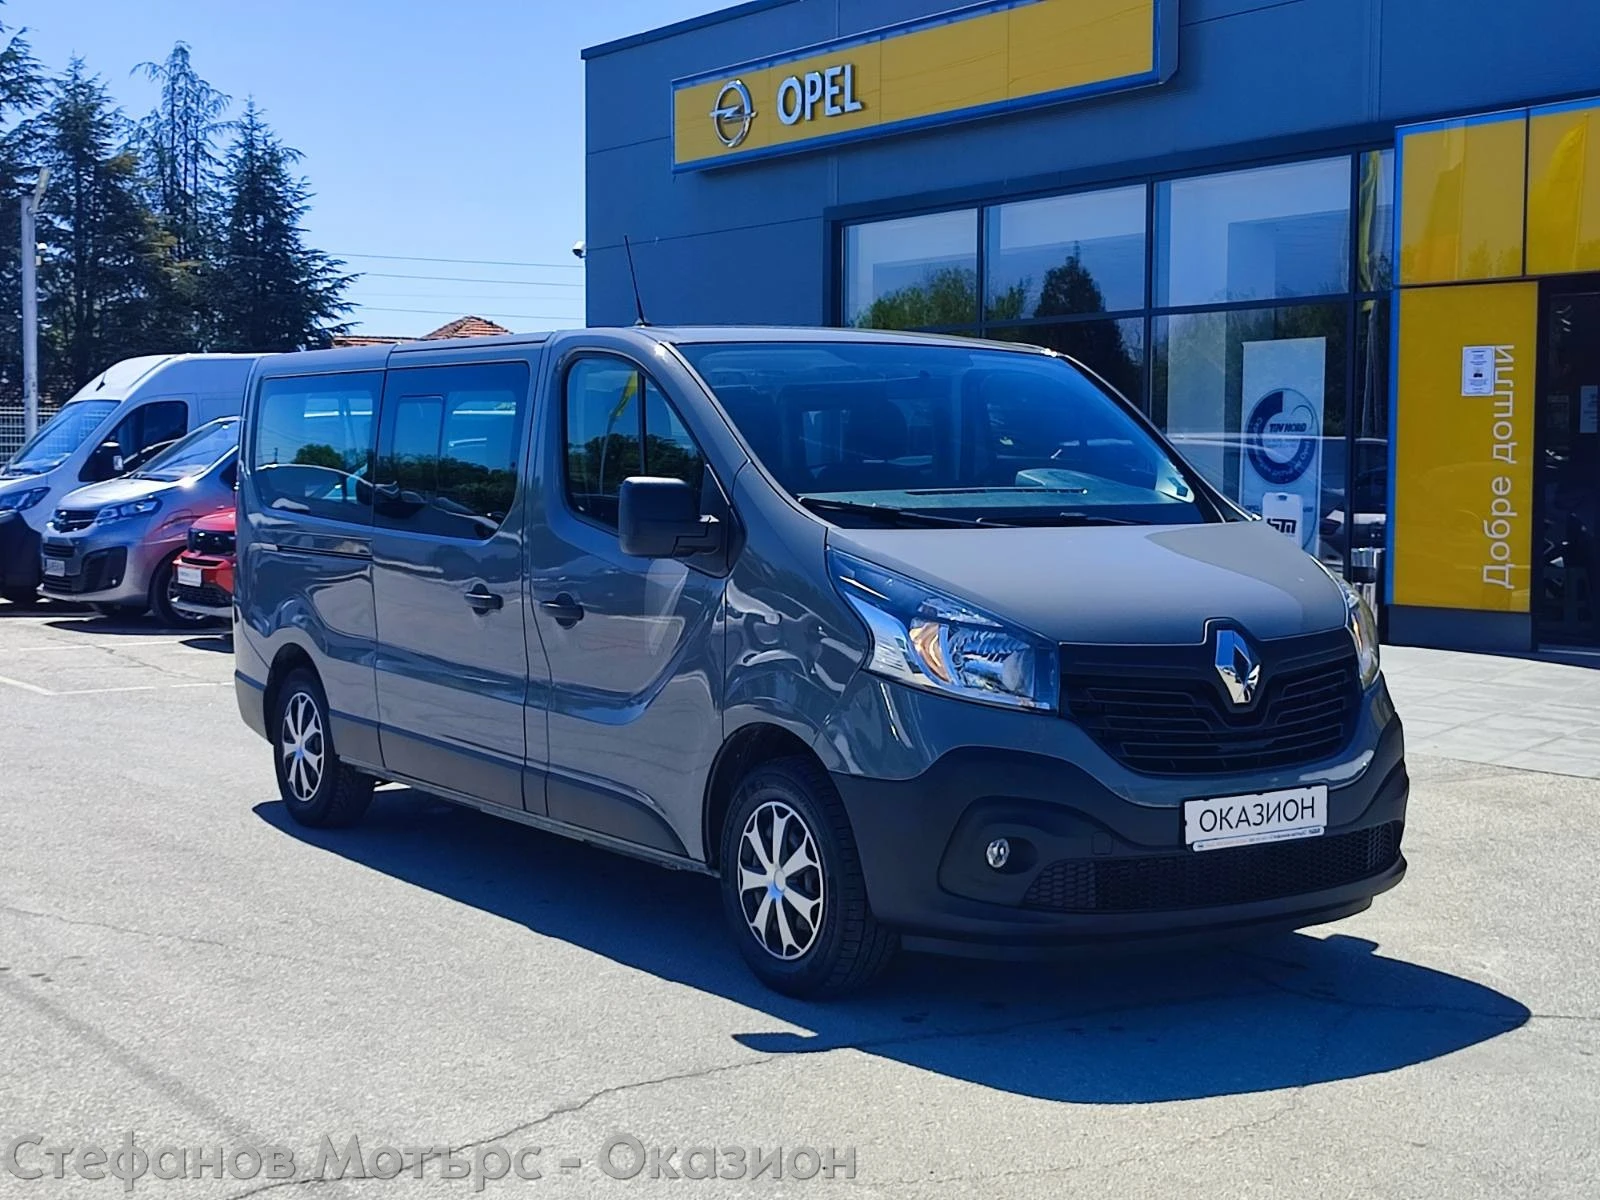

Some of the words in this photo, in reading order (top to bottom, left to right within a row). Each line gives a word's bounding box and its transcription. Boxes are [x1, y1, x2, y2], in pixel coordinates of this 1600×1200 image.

[777, 64, 863, 125] OPEL
[1493, 344, 1517, 464] дошли
[1483, 476, 1517, 589] Добре
[1199, 796, 1315, 832] ОКАЗИОН
